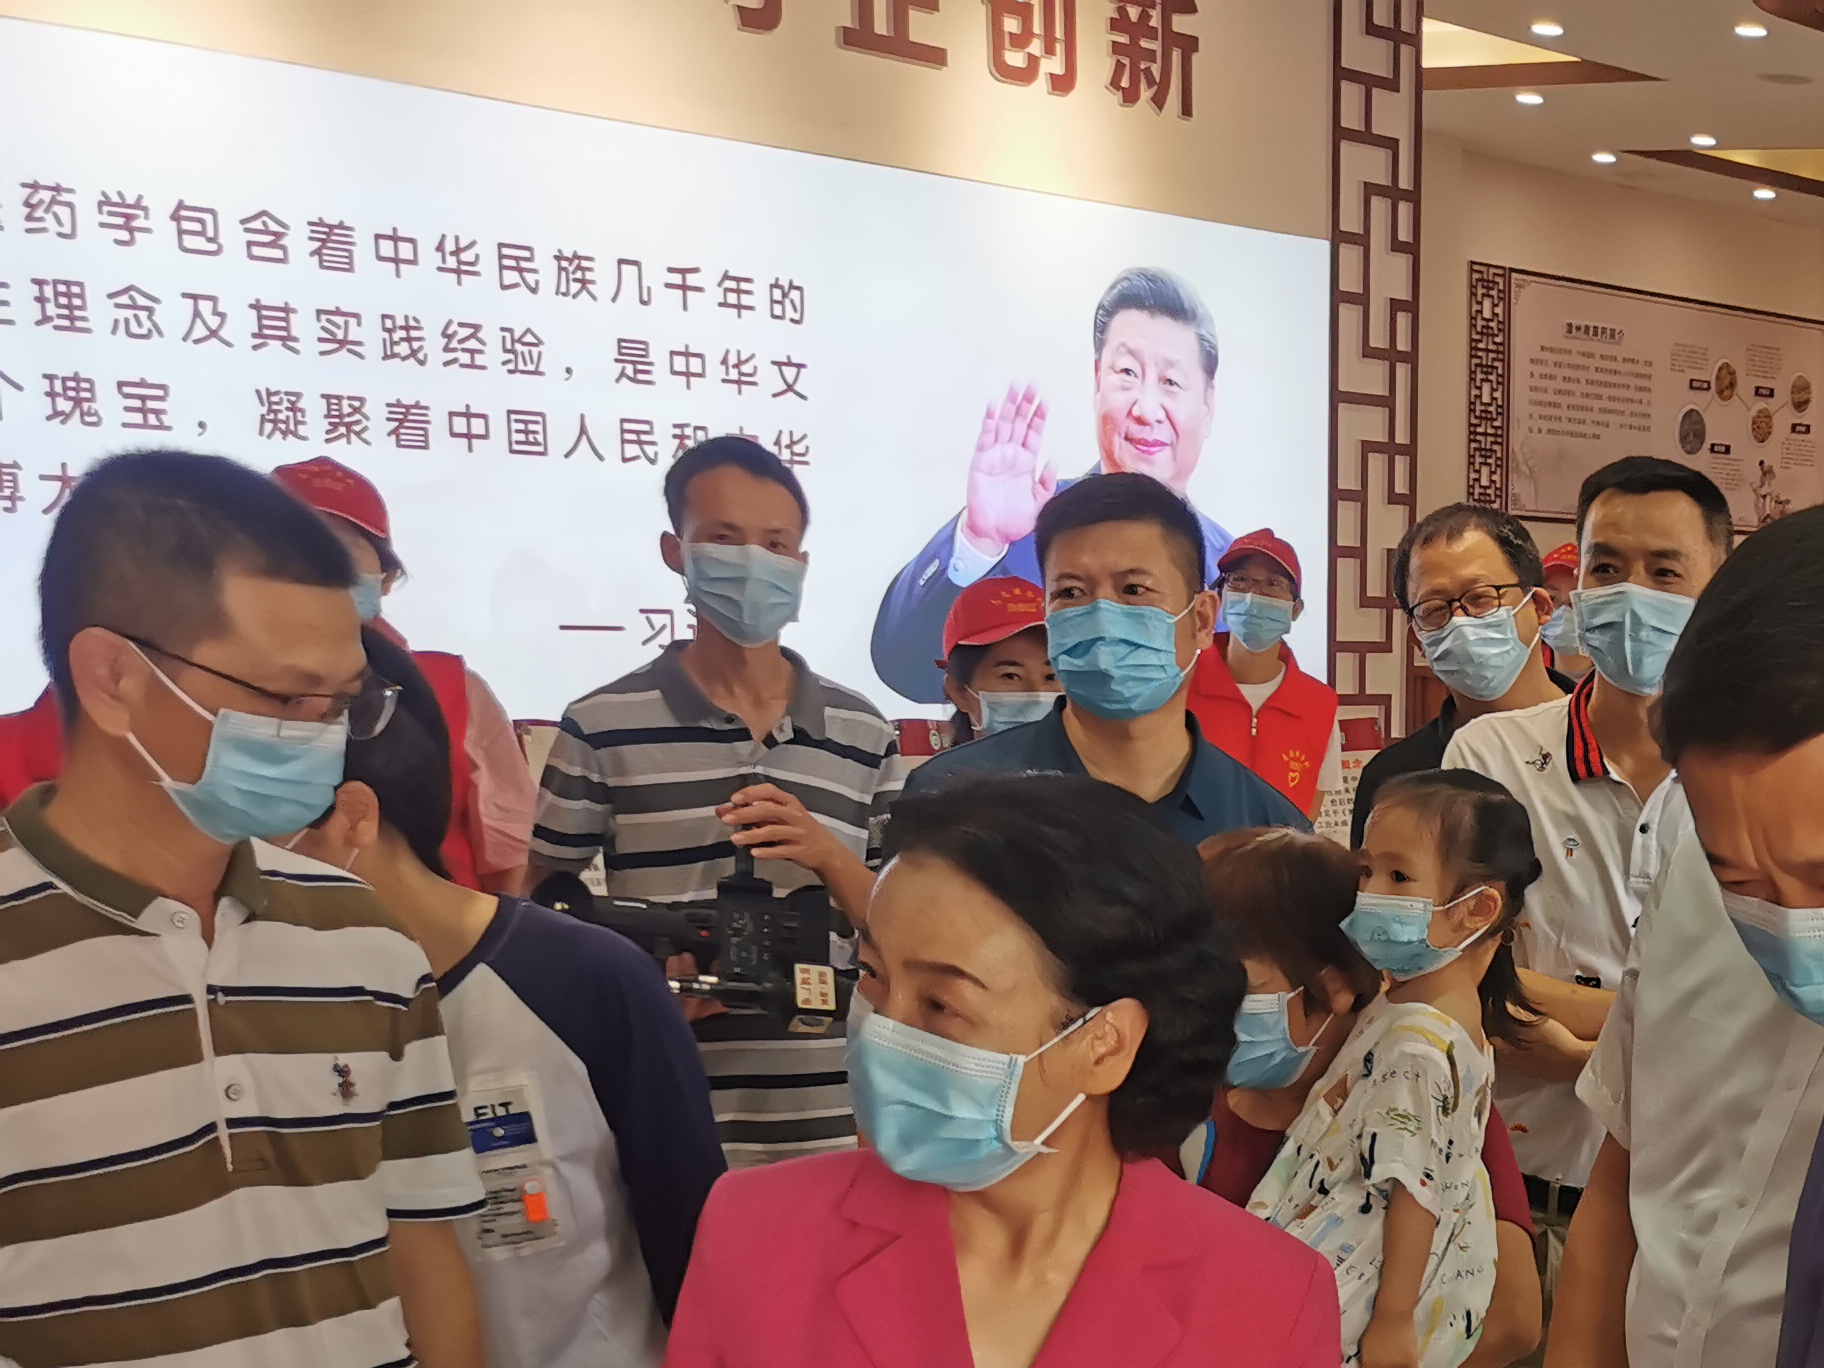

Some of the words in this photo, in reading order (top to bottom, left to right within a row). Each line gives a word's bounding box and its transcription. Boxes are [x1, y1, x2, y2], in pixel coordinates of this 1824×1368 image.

[0, 180, 805, 325] 药学包含着中华民族几千年的
